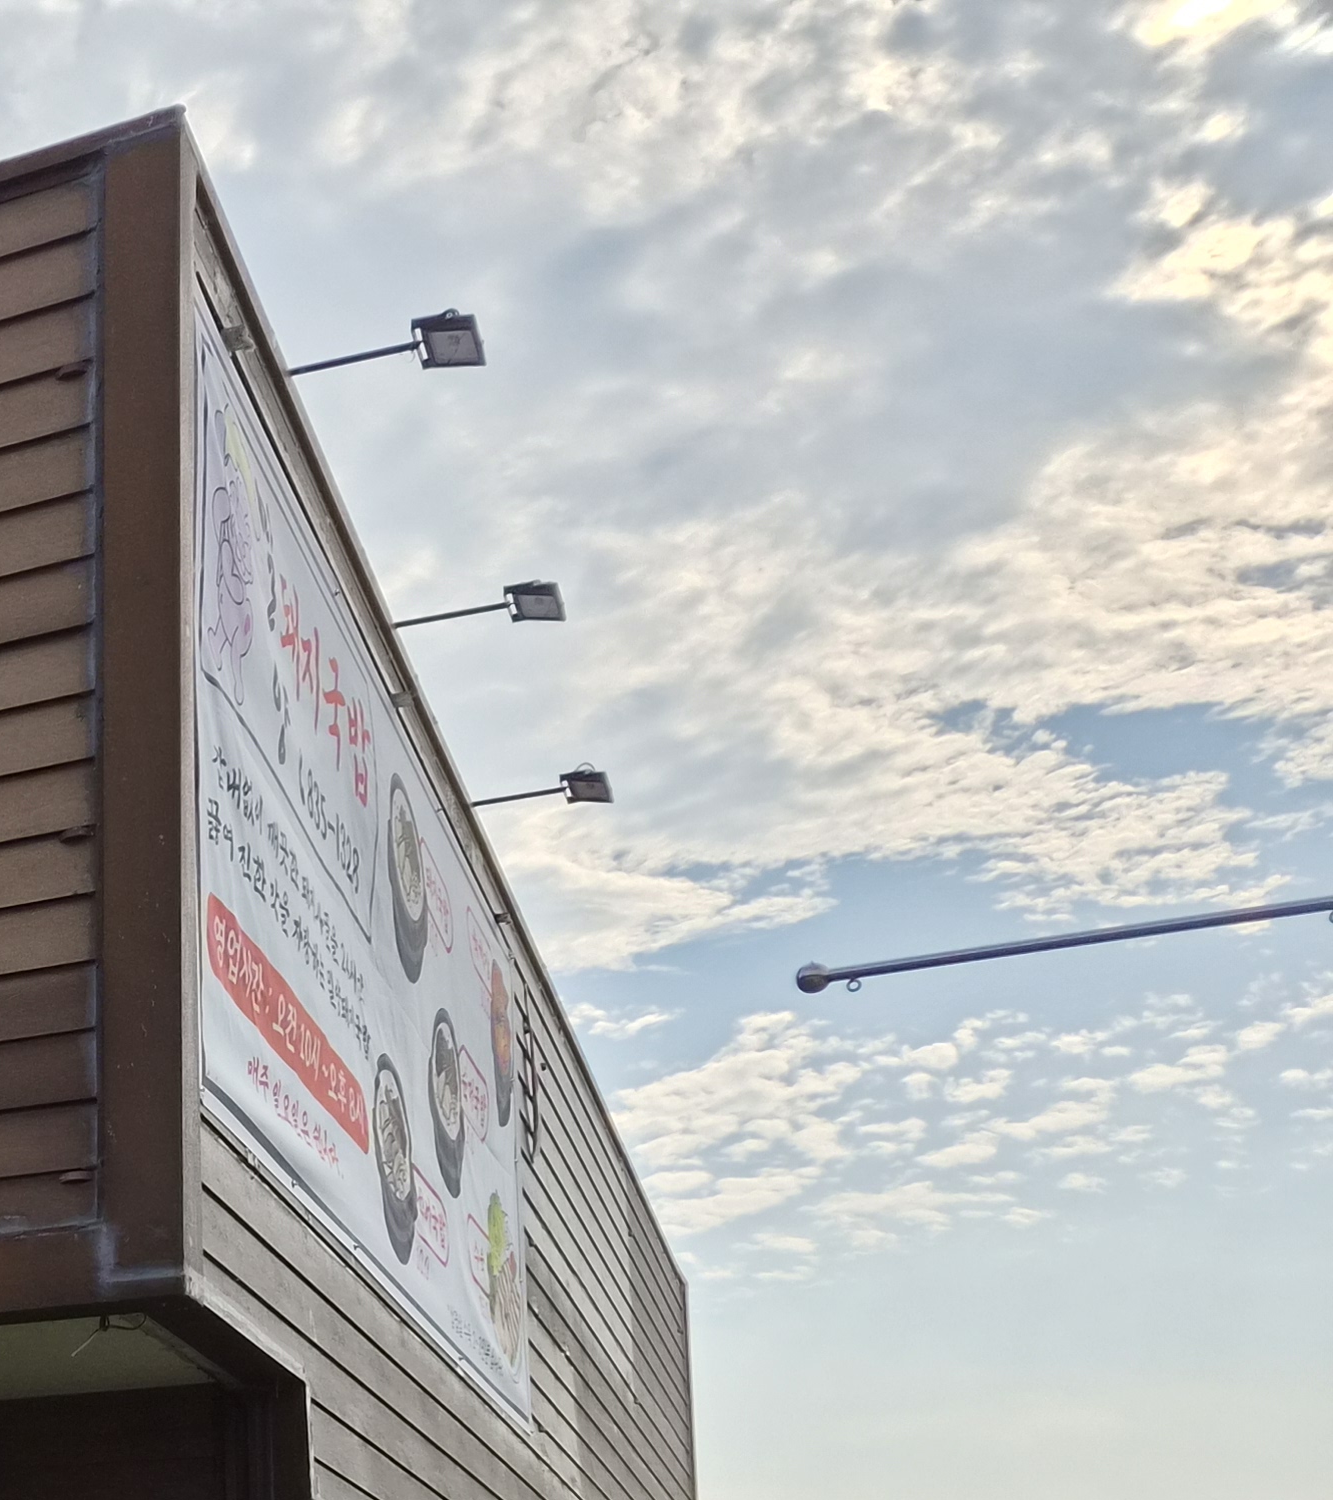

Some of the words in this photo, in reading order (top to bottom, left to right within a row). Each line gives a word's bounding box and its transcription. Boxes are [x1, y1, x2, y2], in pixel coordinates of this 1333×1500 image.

[279, 573, 371, 808] 돼지국밥
[238, 842, 267, 902] 진한
[213, 914, 266, 1014] 영업시간
[272, 993, 298, 1054] 오전
[299, 1023, 321, 1082] 10시
[246, 1056, 270, 1102] 매주
